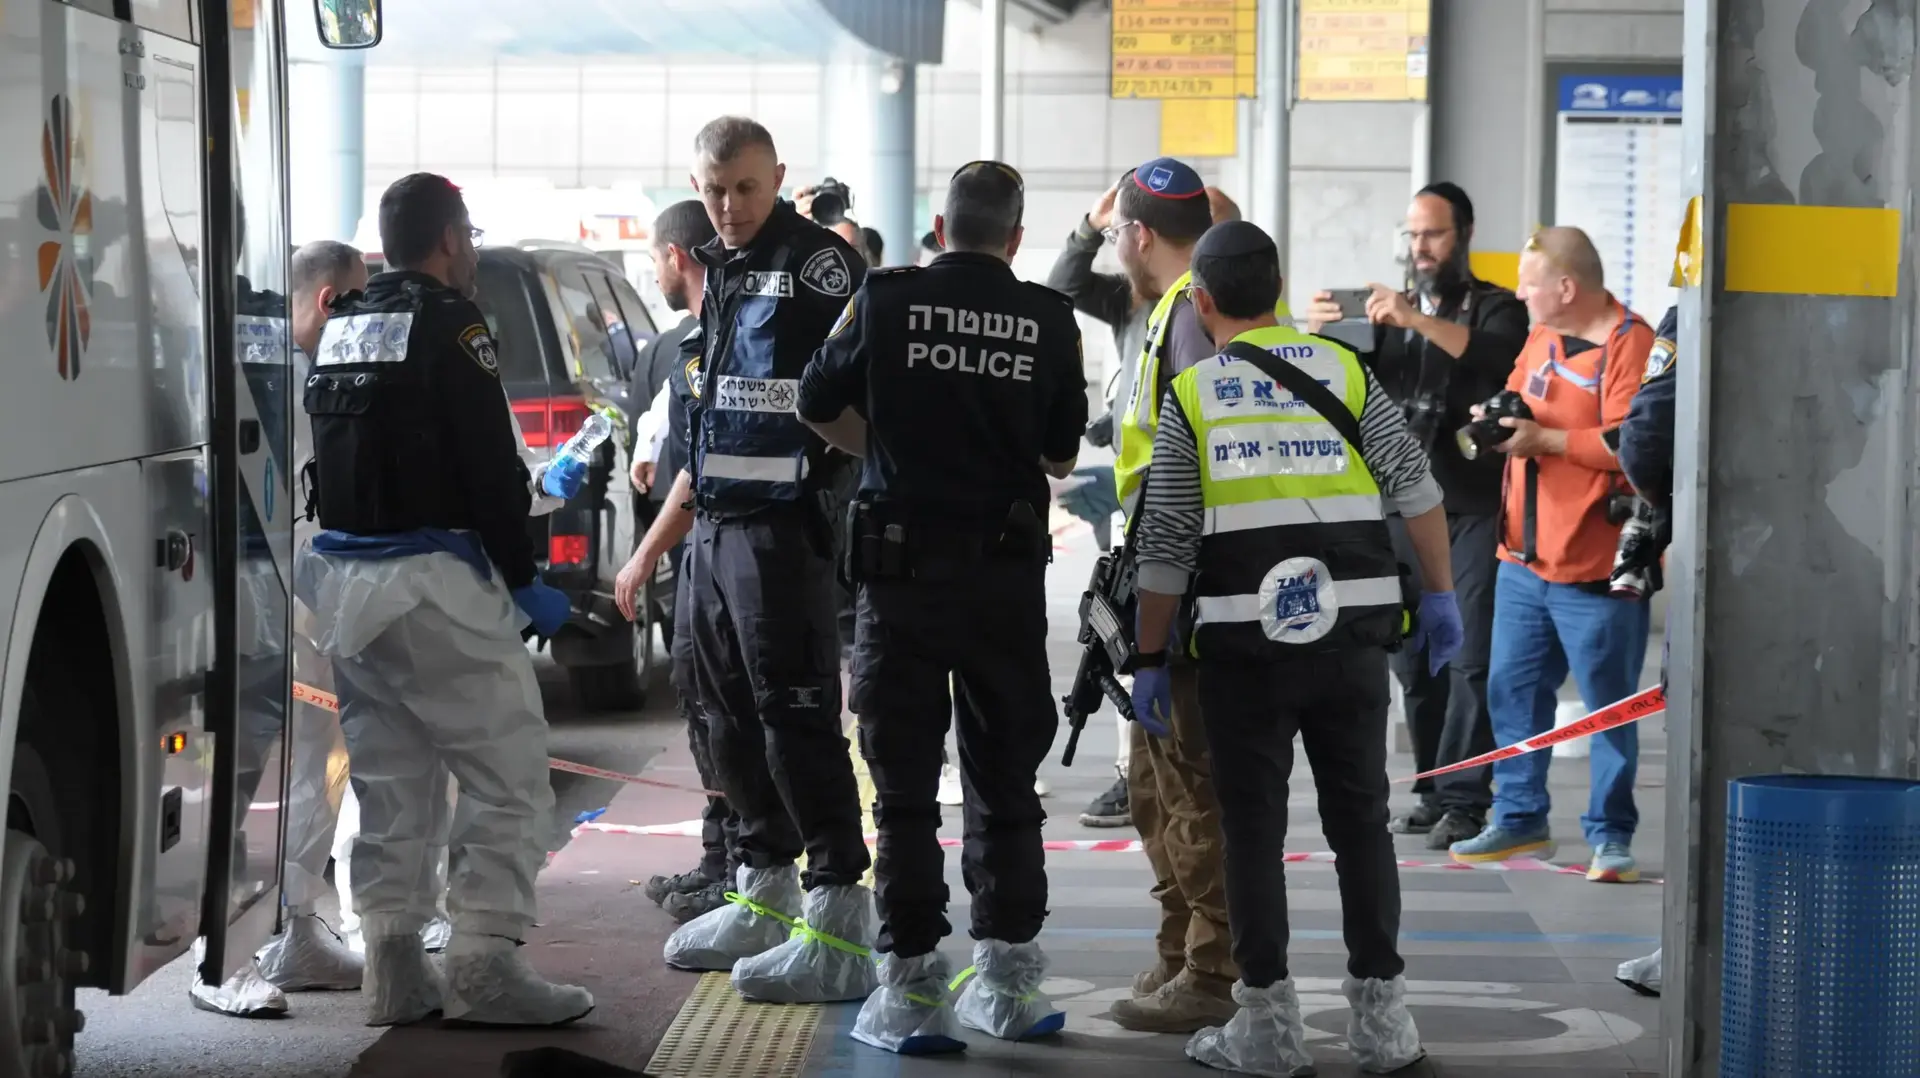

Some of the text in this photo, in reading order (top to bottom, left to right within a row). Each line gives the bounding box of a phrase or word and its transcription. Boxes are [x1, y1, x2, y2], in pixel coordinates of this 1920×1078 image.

[909, 304, 1039, 344] משטרה
[907, 342, 1035, 381] POLICE
[721, 394, 766, 408] ישראל
[1279, 439, 1343, 457] משטרה
[1627, 694, 1665, 715] ישרא
